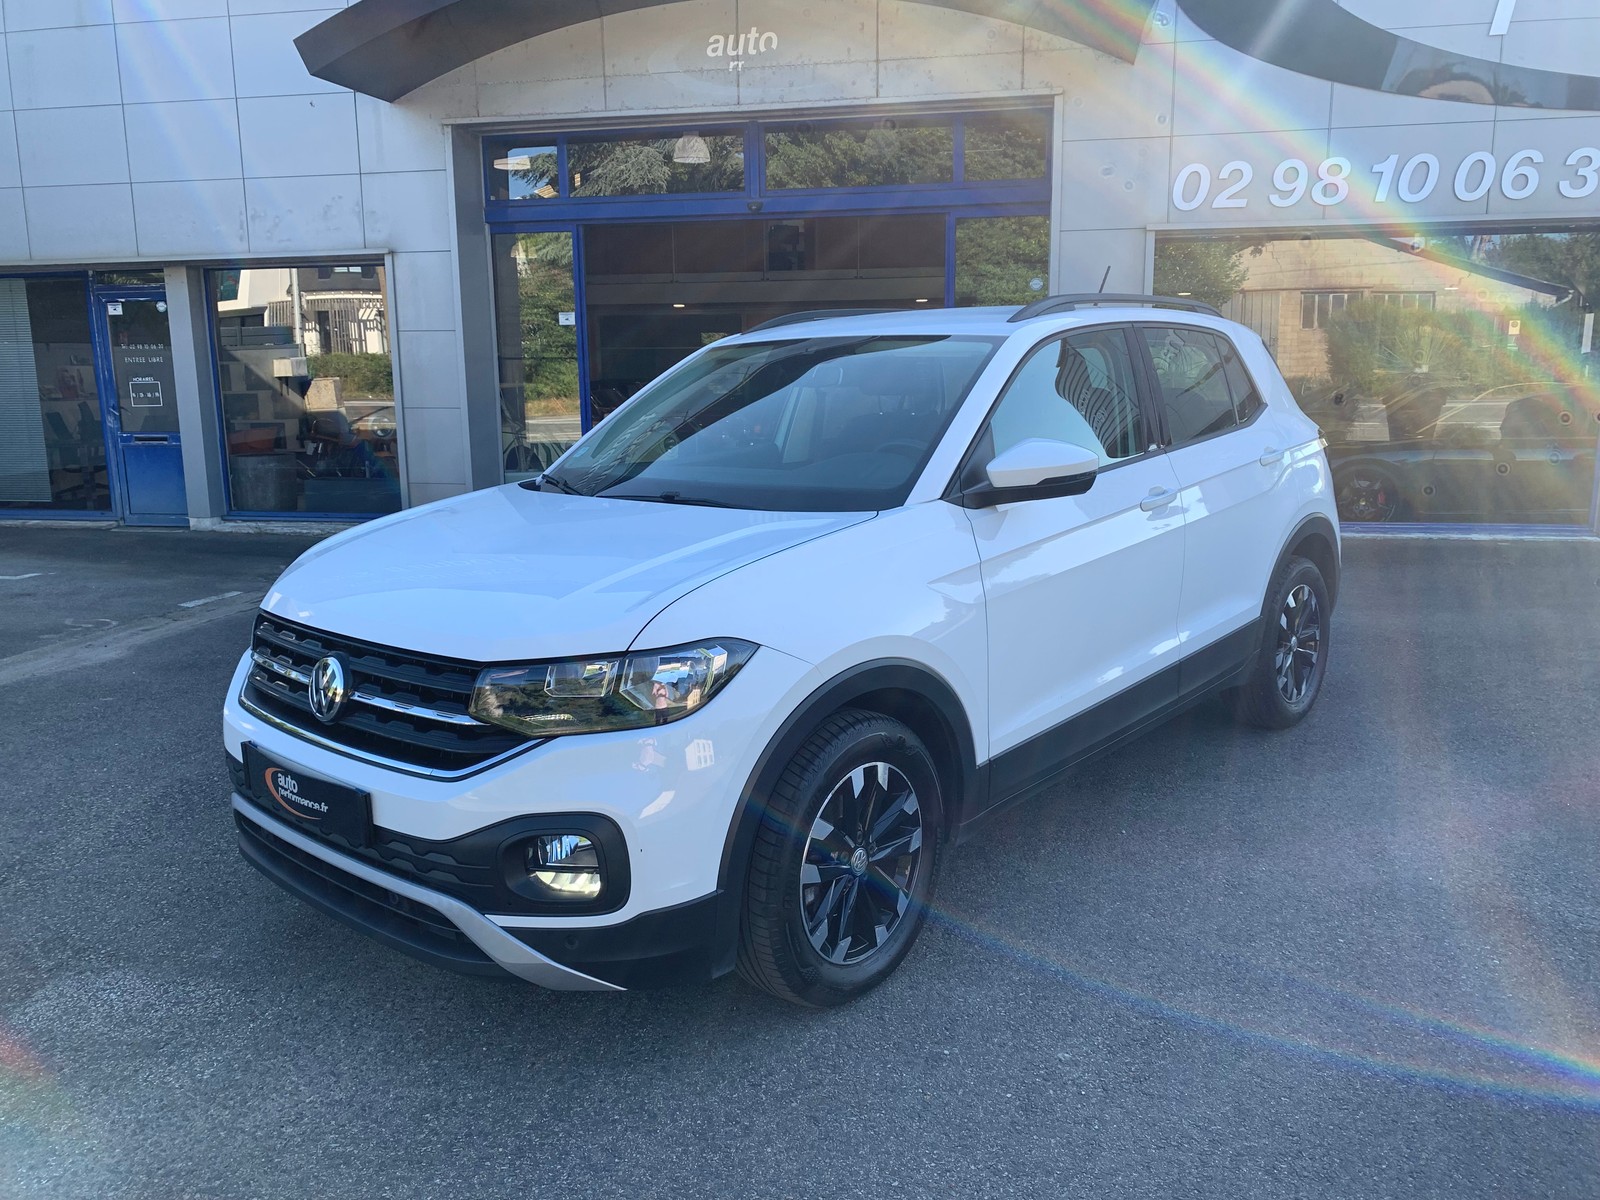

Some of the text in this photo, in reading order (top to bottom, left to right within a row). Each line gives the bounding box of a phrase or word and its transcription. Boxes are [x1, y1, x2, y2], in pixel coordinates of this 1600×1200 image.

[706, 27, 778, 57] auto
[1172, 160, 1253, 211] 02
[1268, 156, 1351, 207] 98
[1370, 153, 1440, 203] 10
[1454, 148, 1544, 202] 06
[277, 772, 299, 794] auto
